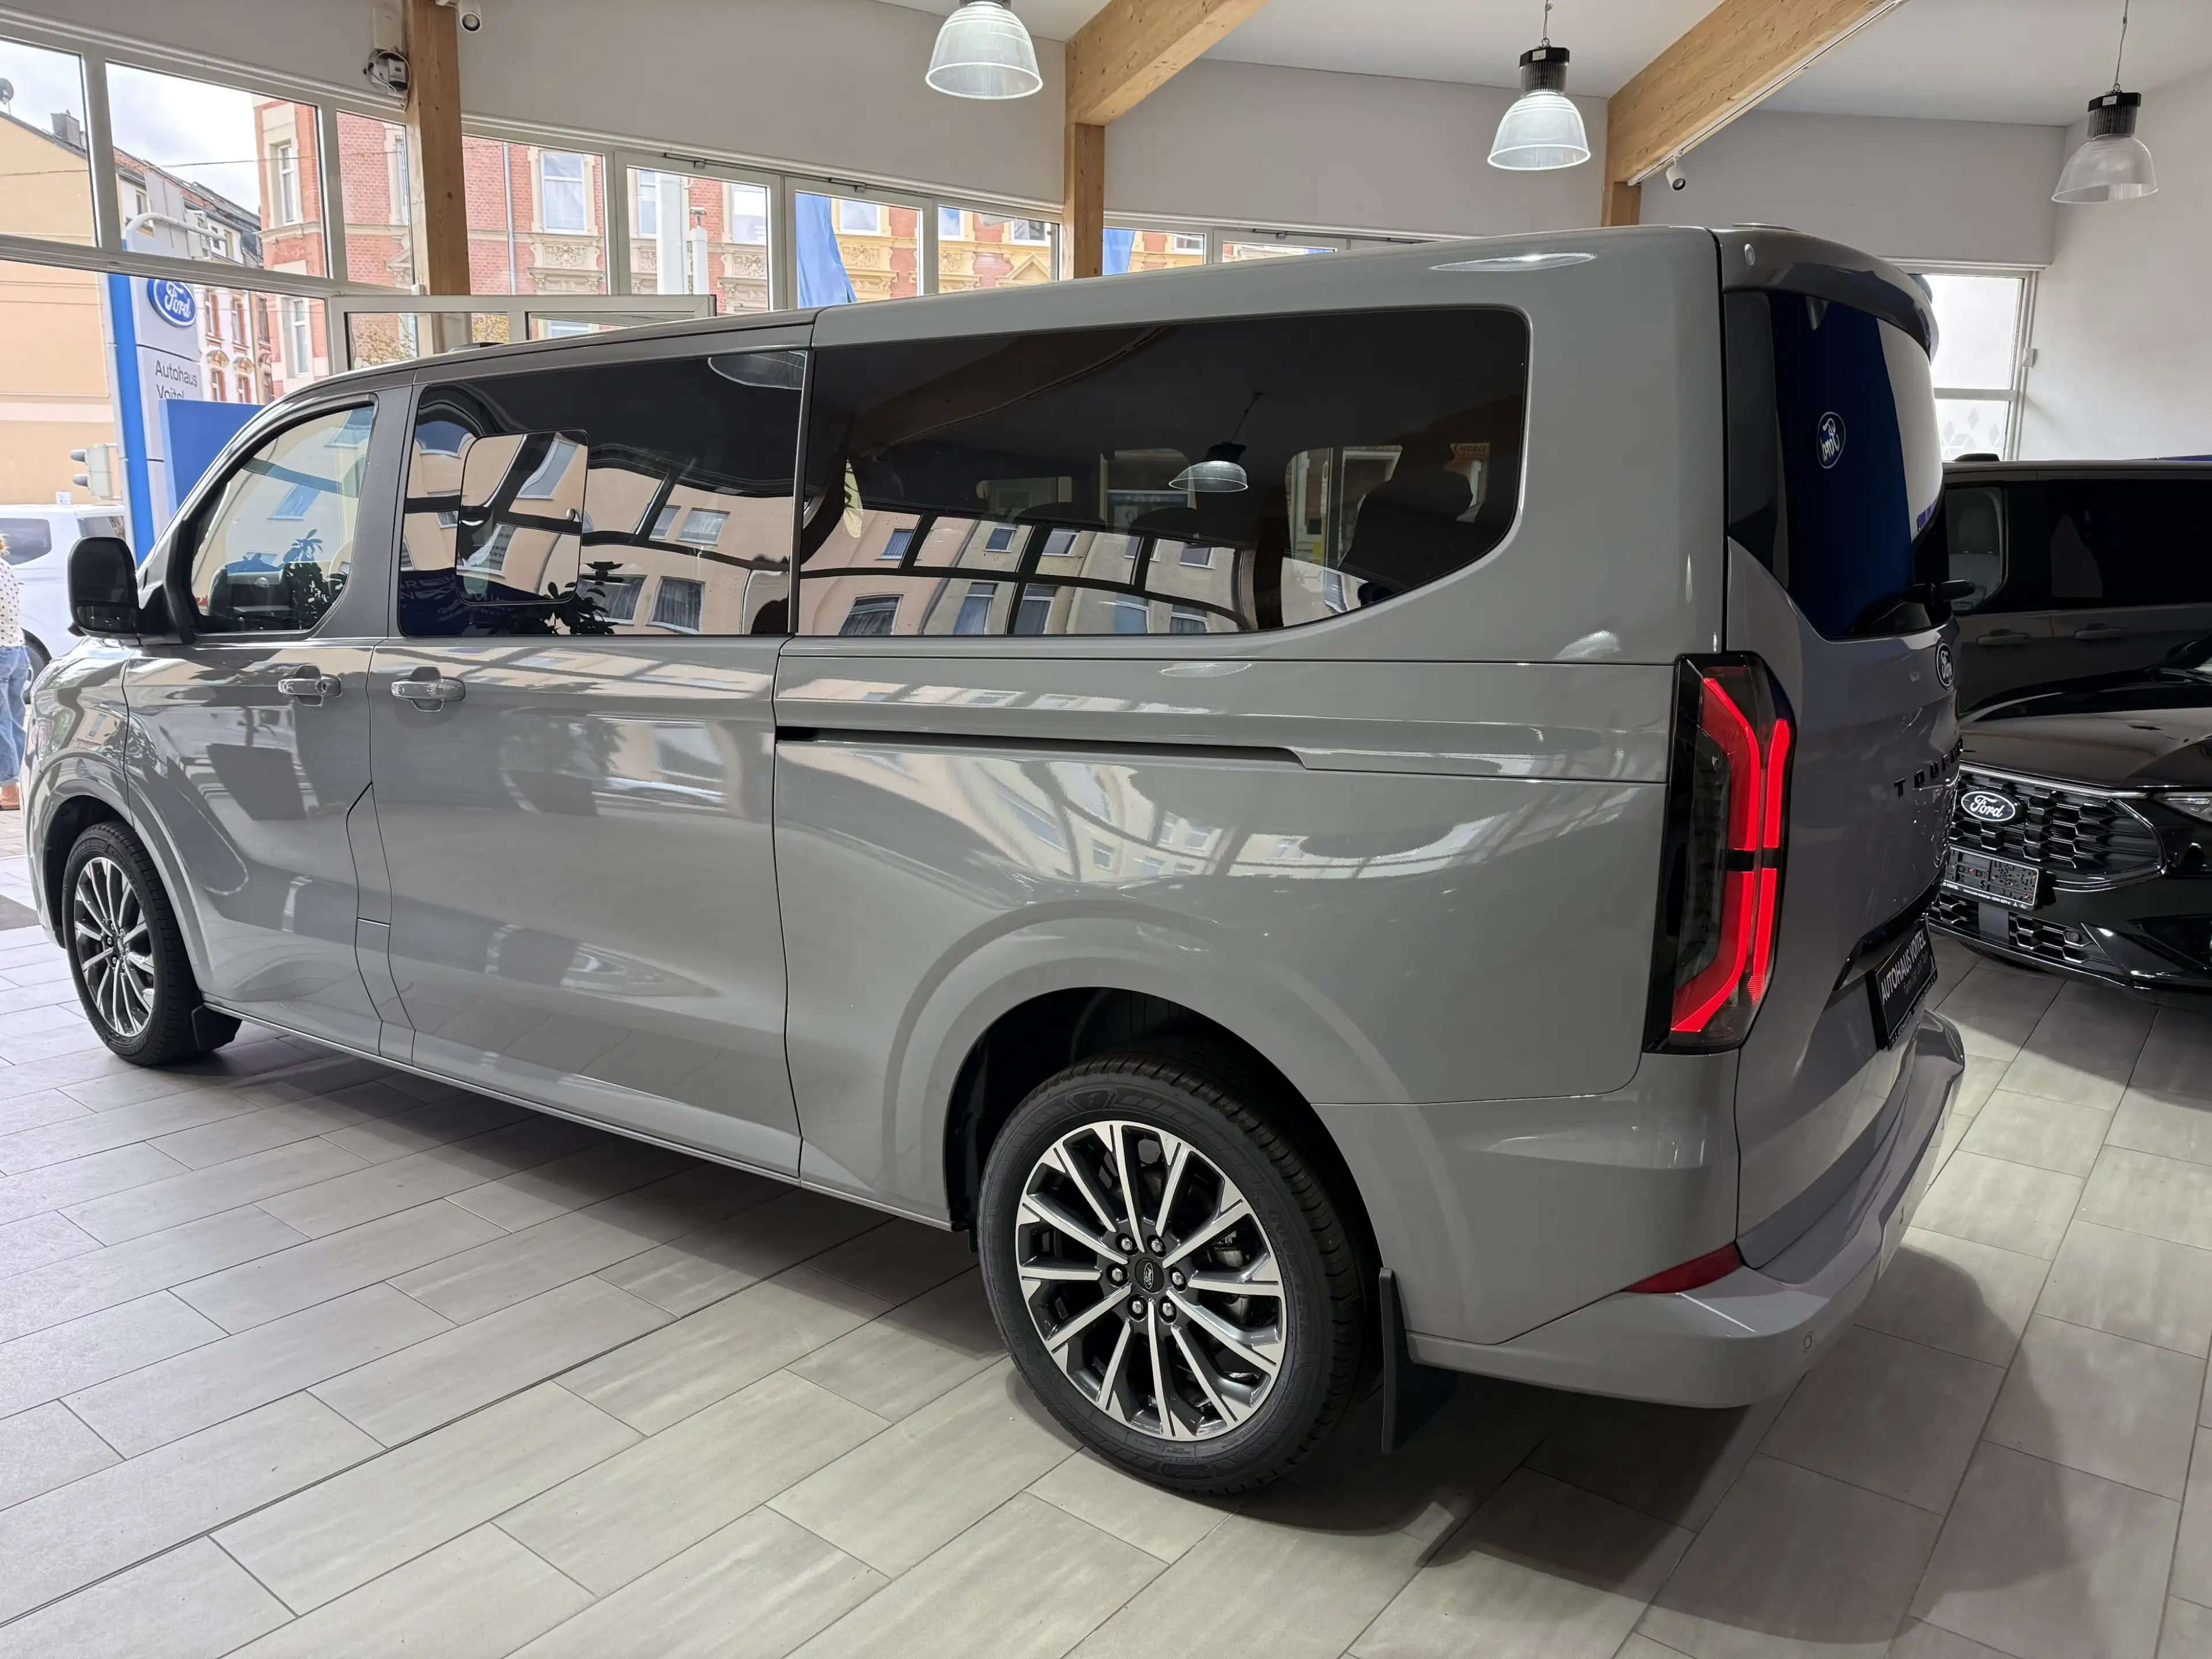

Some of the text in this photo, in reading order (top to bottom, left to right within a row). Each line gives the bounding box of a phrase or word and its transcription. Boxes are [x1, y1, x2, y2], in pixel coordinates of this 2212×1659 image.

[165, 282, 190, 319] Ford
[155, 359, 198, 387] Autohaus
[1969, 795, 2005, 818] Ford
[1880, 949, 1912, 1005] AUTOHAUS
[1908, 930, 1927, 964] VOITEL
[1144, 1267, 1153, 1286] Ford
